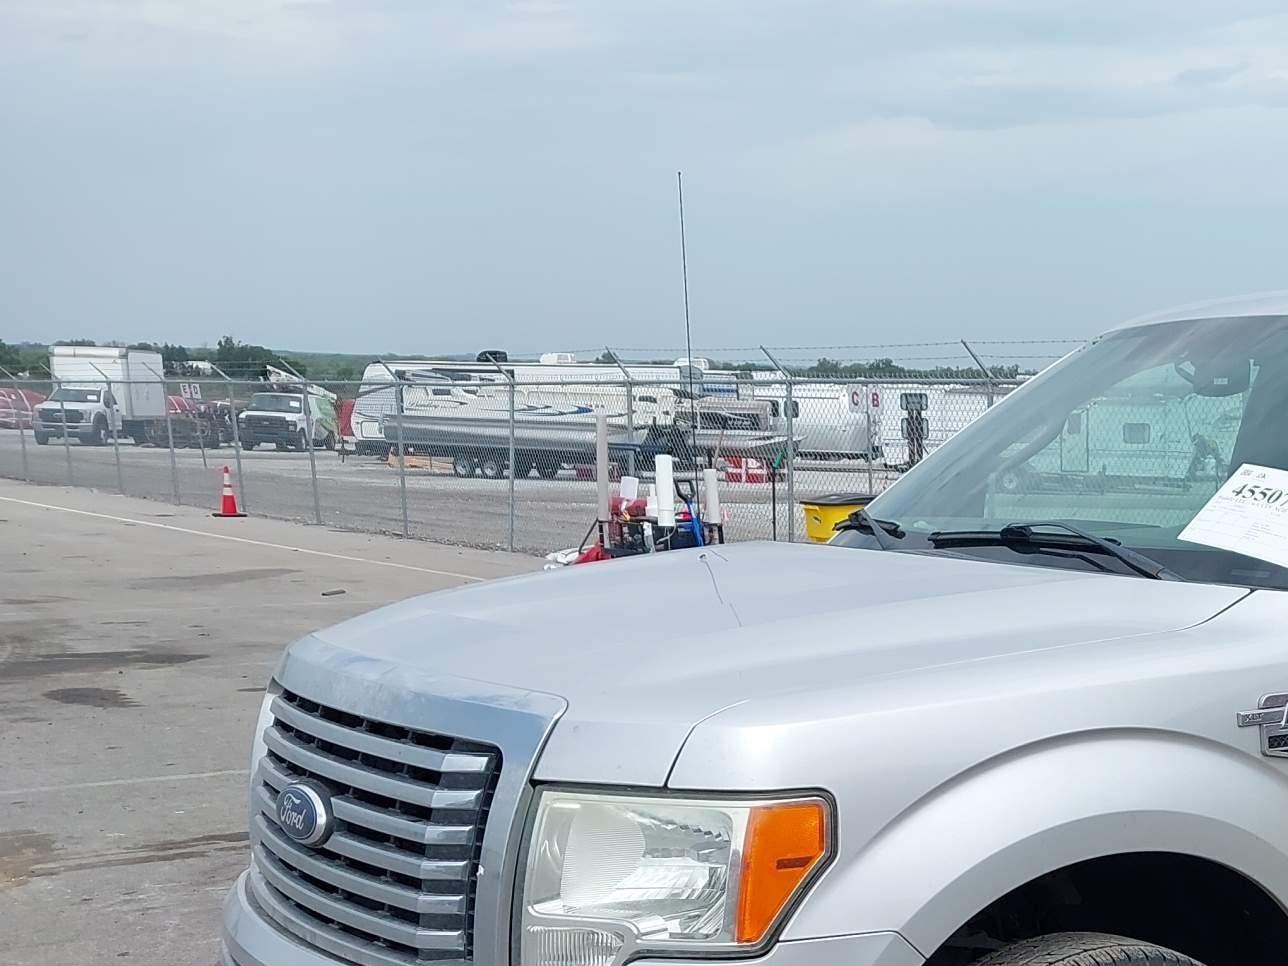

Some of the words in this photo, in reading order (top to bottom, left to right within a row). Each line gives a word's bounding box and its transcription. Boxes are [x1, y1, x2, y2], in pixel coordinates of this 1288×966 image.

[851, 391, 860, 407] C
[871, 392, 880, 408] B
[280, 792, 306, 831] Ford
